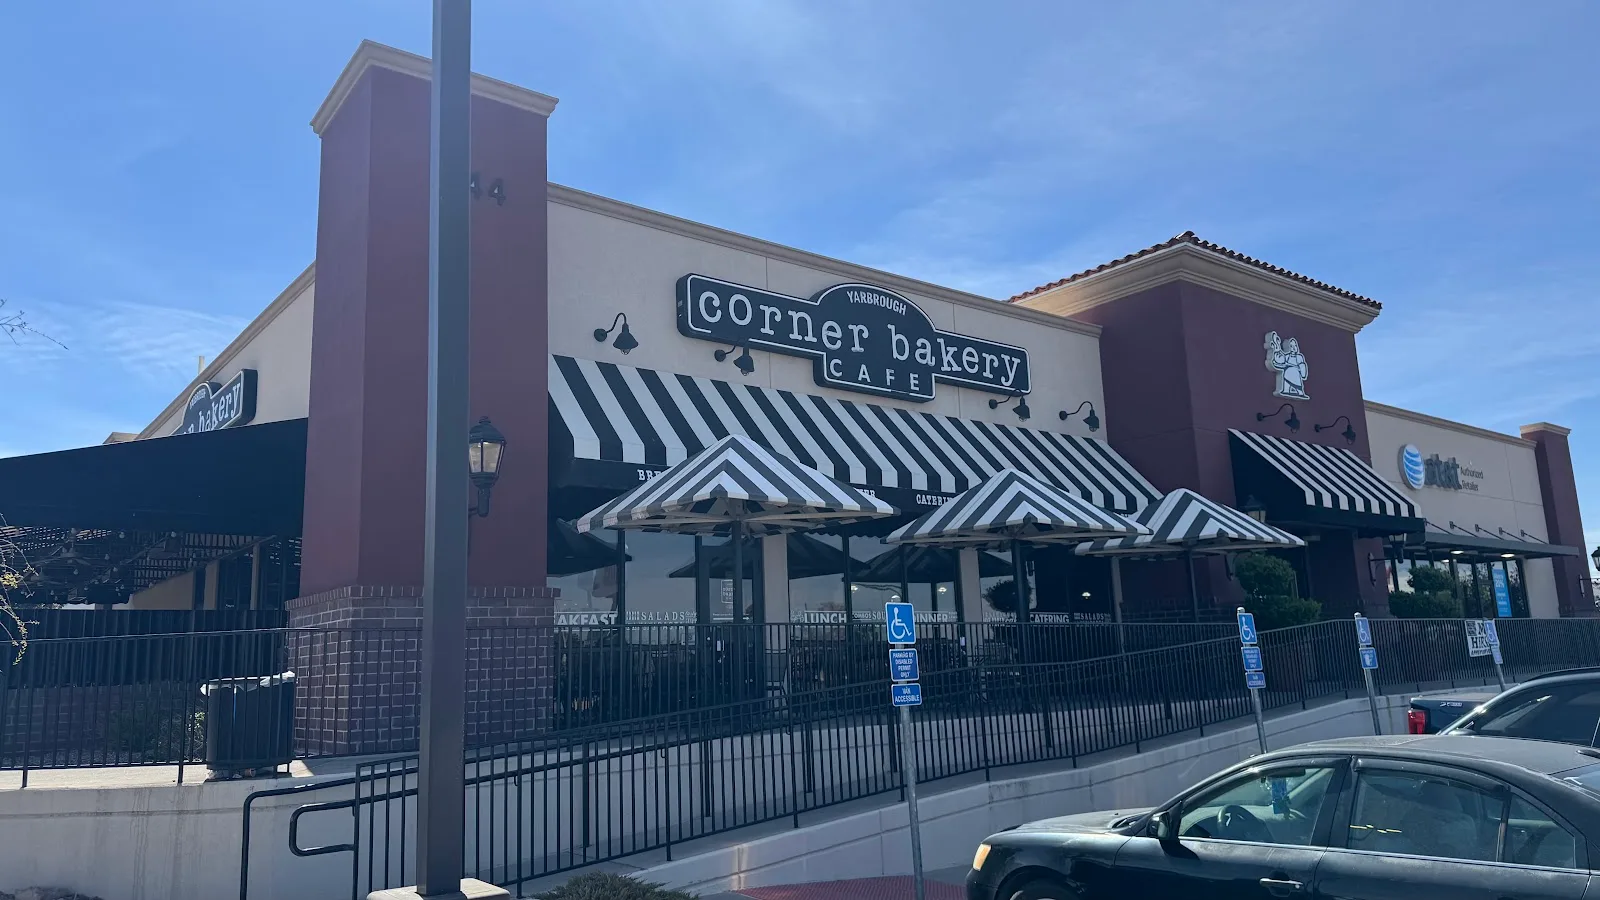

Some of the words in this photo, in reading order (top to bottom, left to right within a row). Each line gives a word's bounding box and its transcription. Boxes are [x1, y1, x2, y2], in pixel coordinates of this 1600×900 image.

[846, 290, 906, 316] YARBROUGH
[699, 290, 869, 353] corner
[888, 323, 1021, 387] bakery
[829, 358, 920, 390] CAFE
[198, 382, 240, 432] bakery
[916, 493, 954, 506] CATERI
[554, 614, 617, 625] AKFAST
[641, 611, 685, 621] SALADS
[804, 612, 847, 624] LUNCH
[872, 611, 886, 620] SOU
[1030, 613, 1070, 623] CATERING
[902, 687, 911, 695] VAN
[895, 695, 920, 703] ACCESSIBLE
